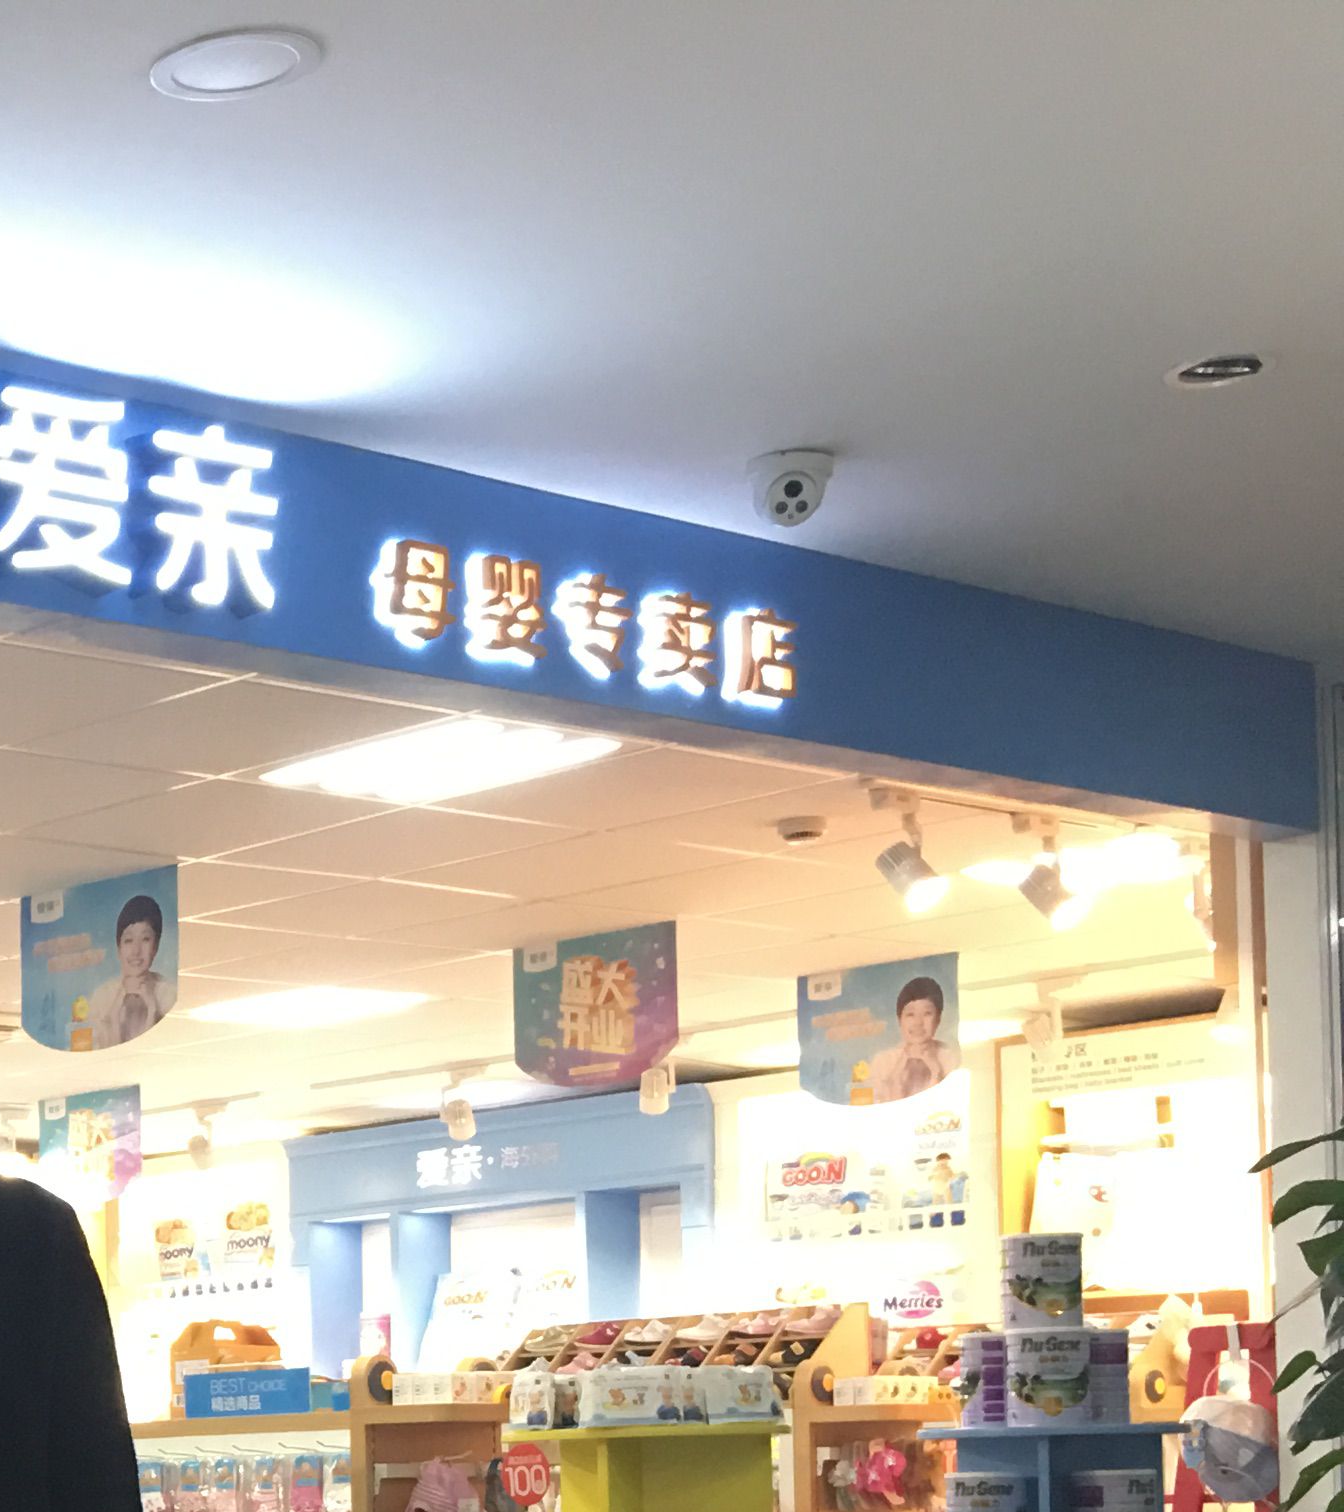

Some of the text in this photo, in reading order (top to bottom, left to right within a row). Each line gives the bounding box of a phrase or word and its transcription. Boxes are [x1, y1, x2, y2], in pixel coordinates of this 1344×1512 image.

[371, 537, 799, 710] 母婴专卖店
[560, 959, 627, 1010] 盛大
[557, 1005, 630, 1055] 开业
[226, 1232, 272, 1252] moony
[884, 1294, 943, 1312] Merries
[209, 1376, 287, 1395] BEST CHOICE
[504, 1464, 548, 1497] 100
